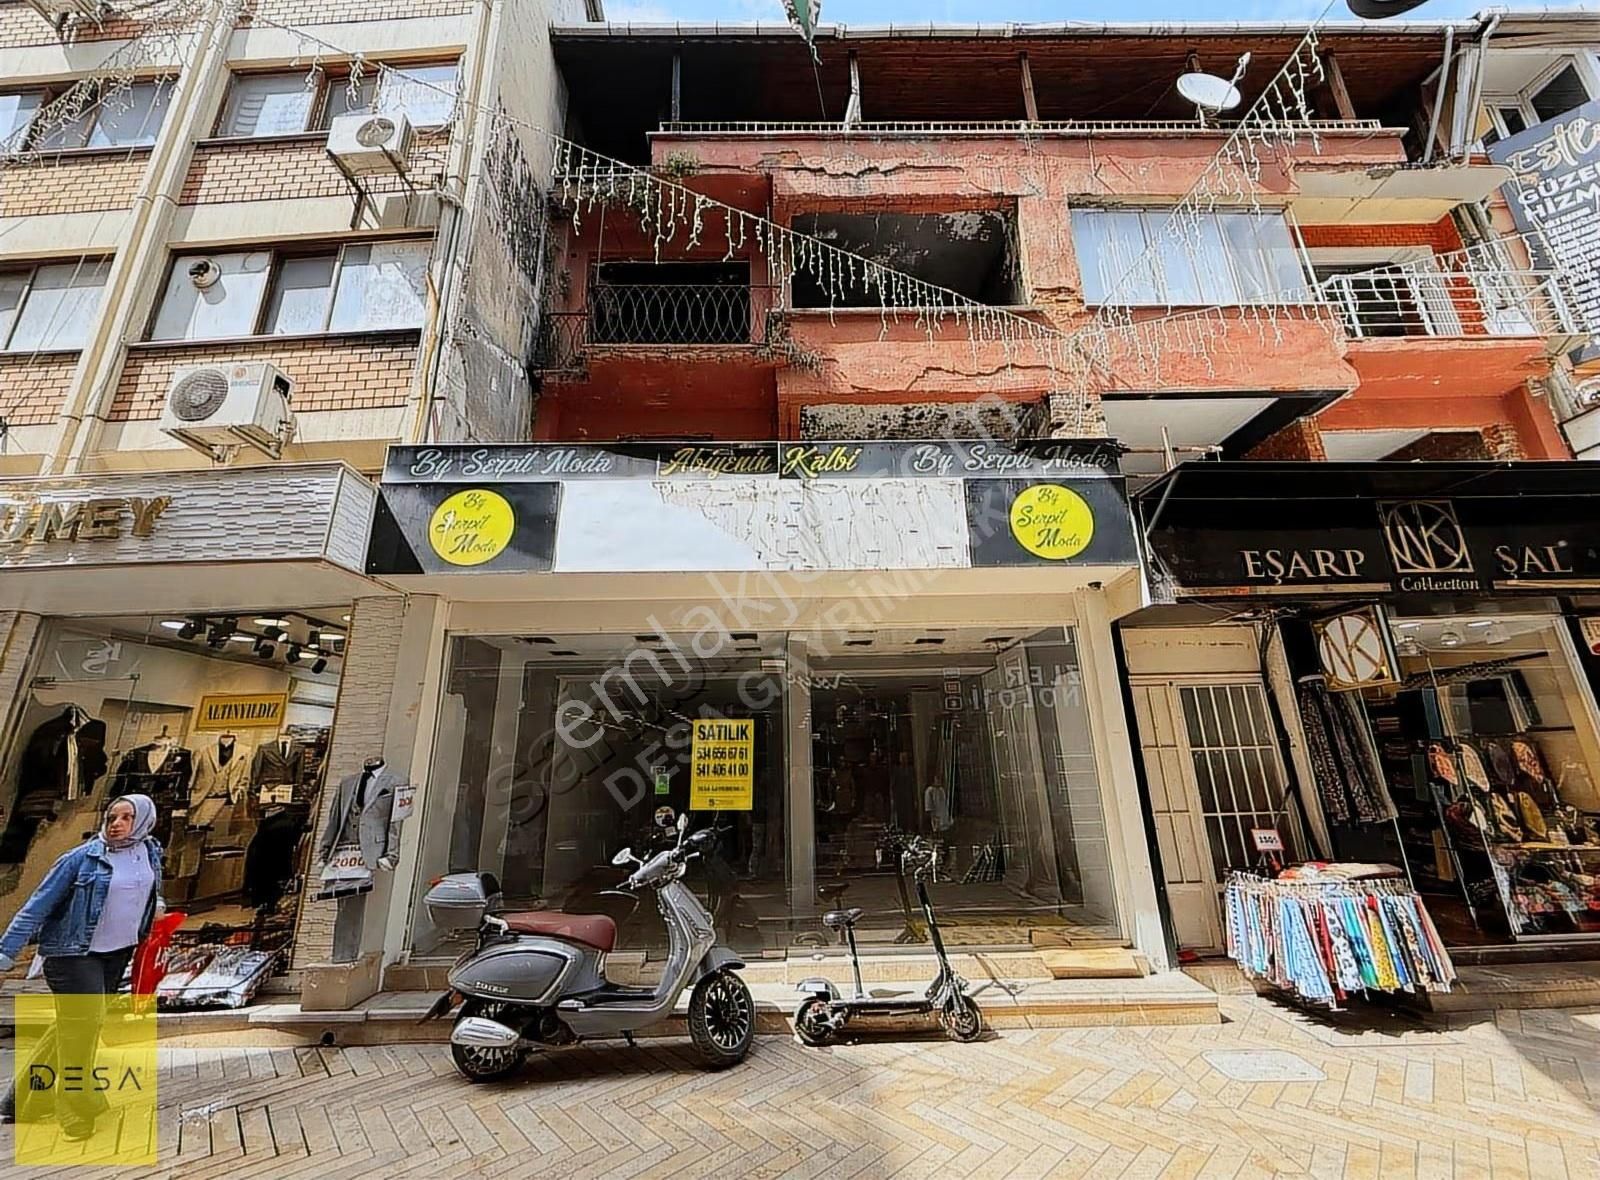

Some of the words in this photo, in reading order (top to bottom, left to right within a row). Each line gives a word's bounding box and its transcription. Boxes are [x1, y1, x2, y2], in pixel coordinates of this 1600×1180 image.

[410, 448, 454, 480] By
[462, 448, 540, 479] Serpil
[541, 449, 612, 475] Moda
[660, 447, 772, 480] Abiyenin
[782, 445, 857, 478] Kalbi
[913, 445, 953, 475] By
[964, 444, 1038, 474] Serpil
[1043, 445, 1112, 474] Moda
[464, 492, 487, 510] By
[1037, 487, 1060, 506] By
[435, 510, 492, 535] Serpil
[1017, 505, 1068, 528] Serpil
[449, 533, 497, 555] Moda
[1034, 527, 1082, 549] Moda
[1240, 549, 1365, 584] EŞARP
[1495, 543, 1573, 579] ŞAL
[1400, 575, 1479, 592] Collection
[697, 724, 749, 741] SATILIK
